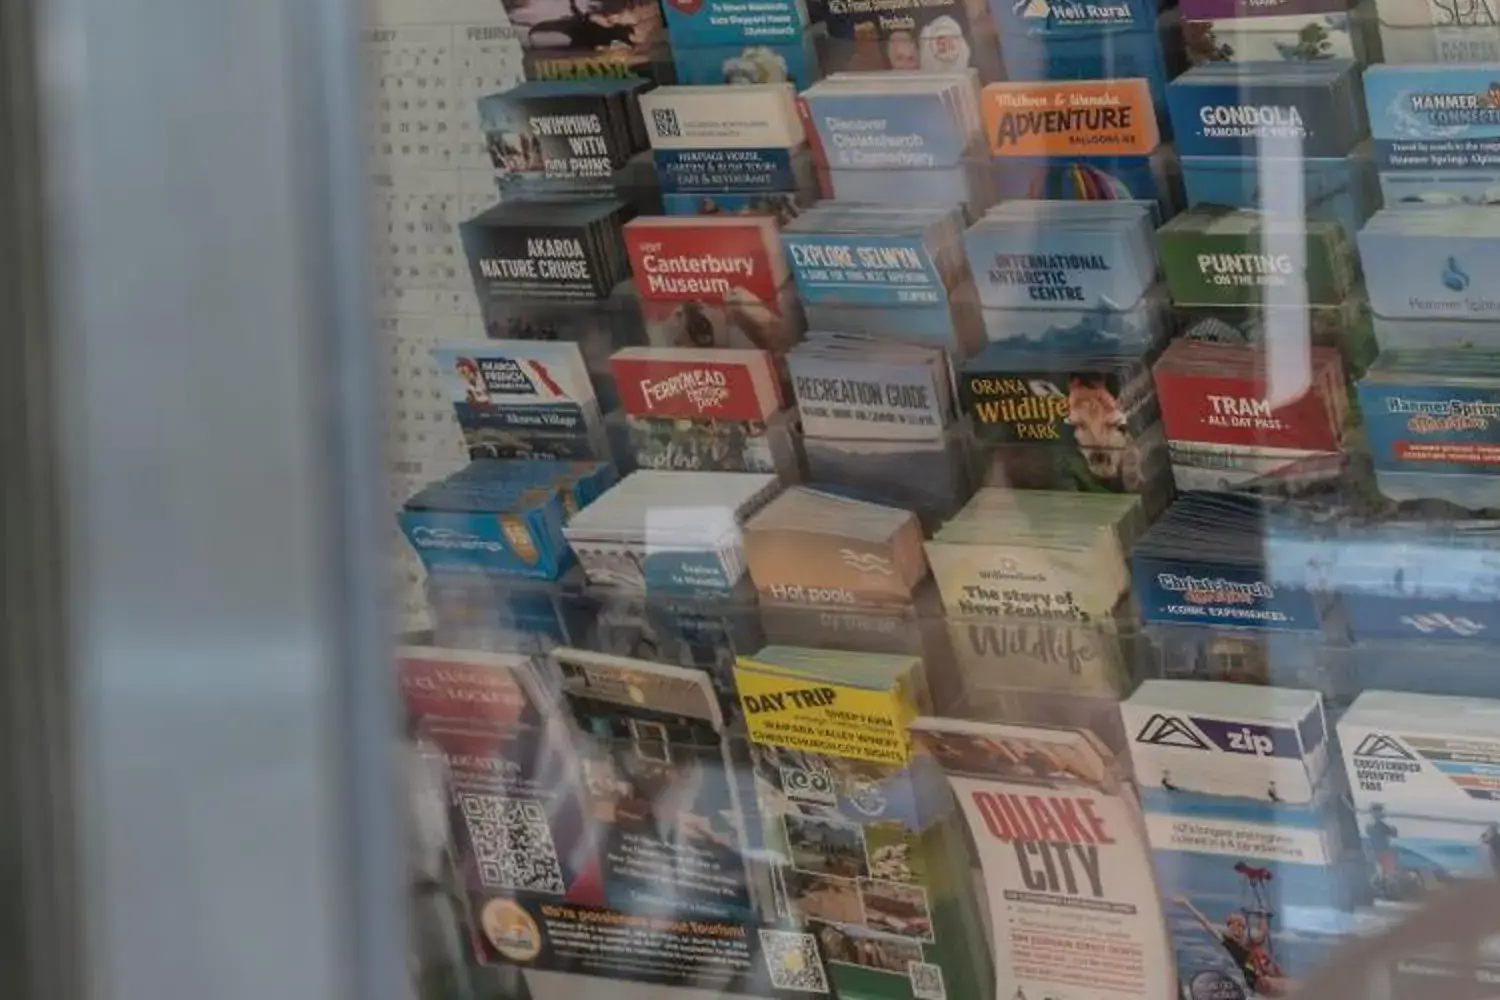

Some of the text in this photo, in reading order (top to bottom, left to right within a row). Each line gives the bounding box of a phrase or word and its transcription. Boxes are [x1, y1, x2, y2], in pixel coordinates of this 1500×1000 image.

[1052, 3, 1131, 21] Heli Rural
[1412, 95, 1477, 110] HANMER
[1200, 105, 1303, 127] GONDOLA
[997, 106, 1132, 148] ADVENTURE
[569, 137, 607, 155] WITH
[527, 239, 584, 259] AKAROA
[790, 244, 857, 268] EXPLORE
[480, 258, 591, 279] NATURE CRUISE
[643, 254, 754, 277] Canterbury
[994, 253, 1110, 271] INTERNATIONAL
[1198, 254, 1293, 274] PUNTING
[646, 275, 730, 293] Museum
[988, 269, 1067, 286] ANTARCTIC
[1029, 286, 1084, 301] CENTRE
[640, 370, 726, 409] FERRYMEAD
[797, 376, 931, 409] RECREATION GUIDE
[971, 378, 1027, 395] ORANA
[976, 397, 1071, 423] Wildlife
[1207, 396, 1272, 417] TRAM
[1016, 423, 1061, 440] PARK
[1208, 417, 1282, 431] ALL DAY PASS
[771, 583, 856, 605] Hot pools
[962, 585, 1074, 606] The story of
[959, 601, 1091, 622] New Zealand's
[1208, 607, 1287, 622] EXPERIENCES
[967, 624, 1097, 673] Wildlife
[744, 687, 837, 713] DAY TRIP
[818, 725, 854, 740] VALLEY
[1226, 727, 1275, 757] zip
[971, 791, 1116, 845] QUAKE
[1012, 839, 1104, 898] CITY
